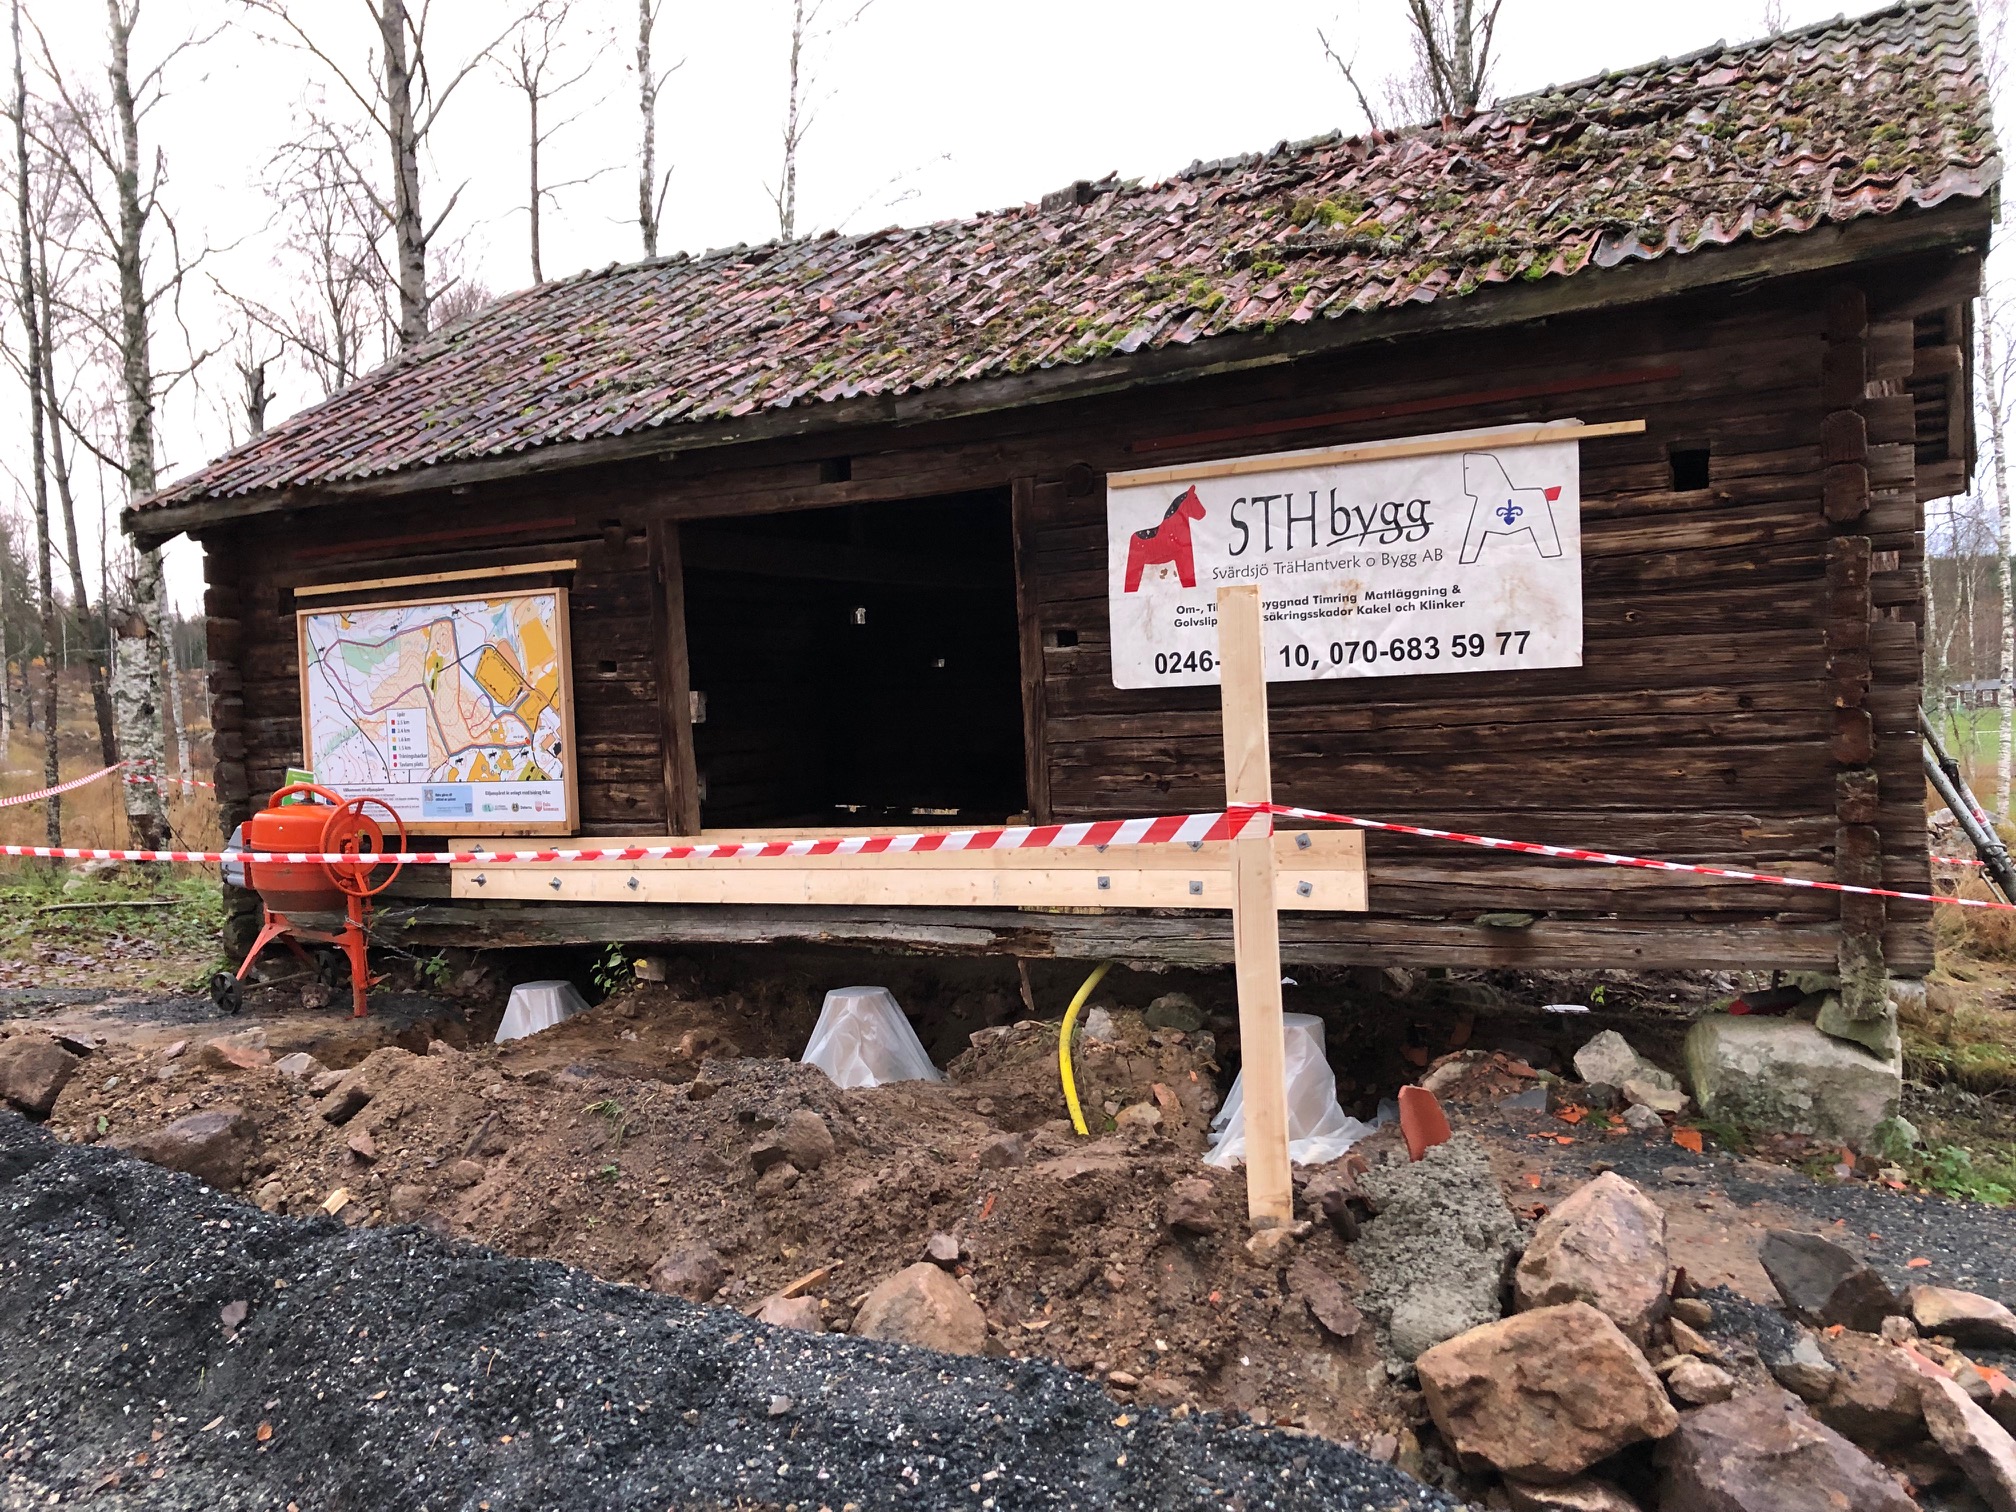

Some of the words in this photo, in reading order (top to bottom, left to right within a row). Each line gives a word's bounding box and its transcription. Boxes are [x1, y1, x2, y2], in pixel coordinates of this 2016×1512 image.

[1212, 564, 1269, 580] Svärdsjö
[1273, 555, 1361, 576] TräHantverk
[1365, 556, 1376, 567] o
[1381, 552, 1417, 569] Bygg
[1422, 548, 1443, 563] AB
[1173, 616, 1218, 628] Golvslip
[1262, 604, 1354, 622] säkringsskador
[1356, 602, 1391, 616] Kakel
[1394, 601, 1416, 613] och
[1419, 599, 1466, 611] Klinker
[1176, 605, 1204, 615] Om-,
[1262, 595, 1310, 611] yggnad
[1311, 593, 1357, 606] Timring
[1364, 586, 1448, 601] Mattläggning
[1452, 584, 1461, 595] &
[1153, 649, 1224, 675] 0246-
[1279, 644, 1320, 671] 10,
[1329, 637, 1441, 665] 070-683
[1451, 633, 1485, 659] 59
[1495, 630, 1531, 656] 77
